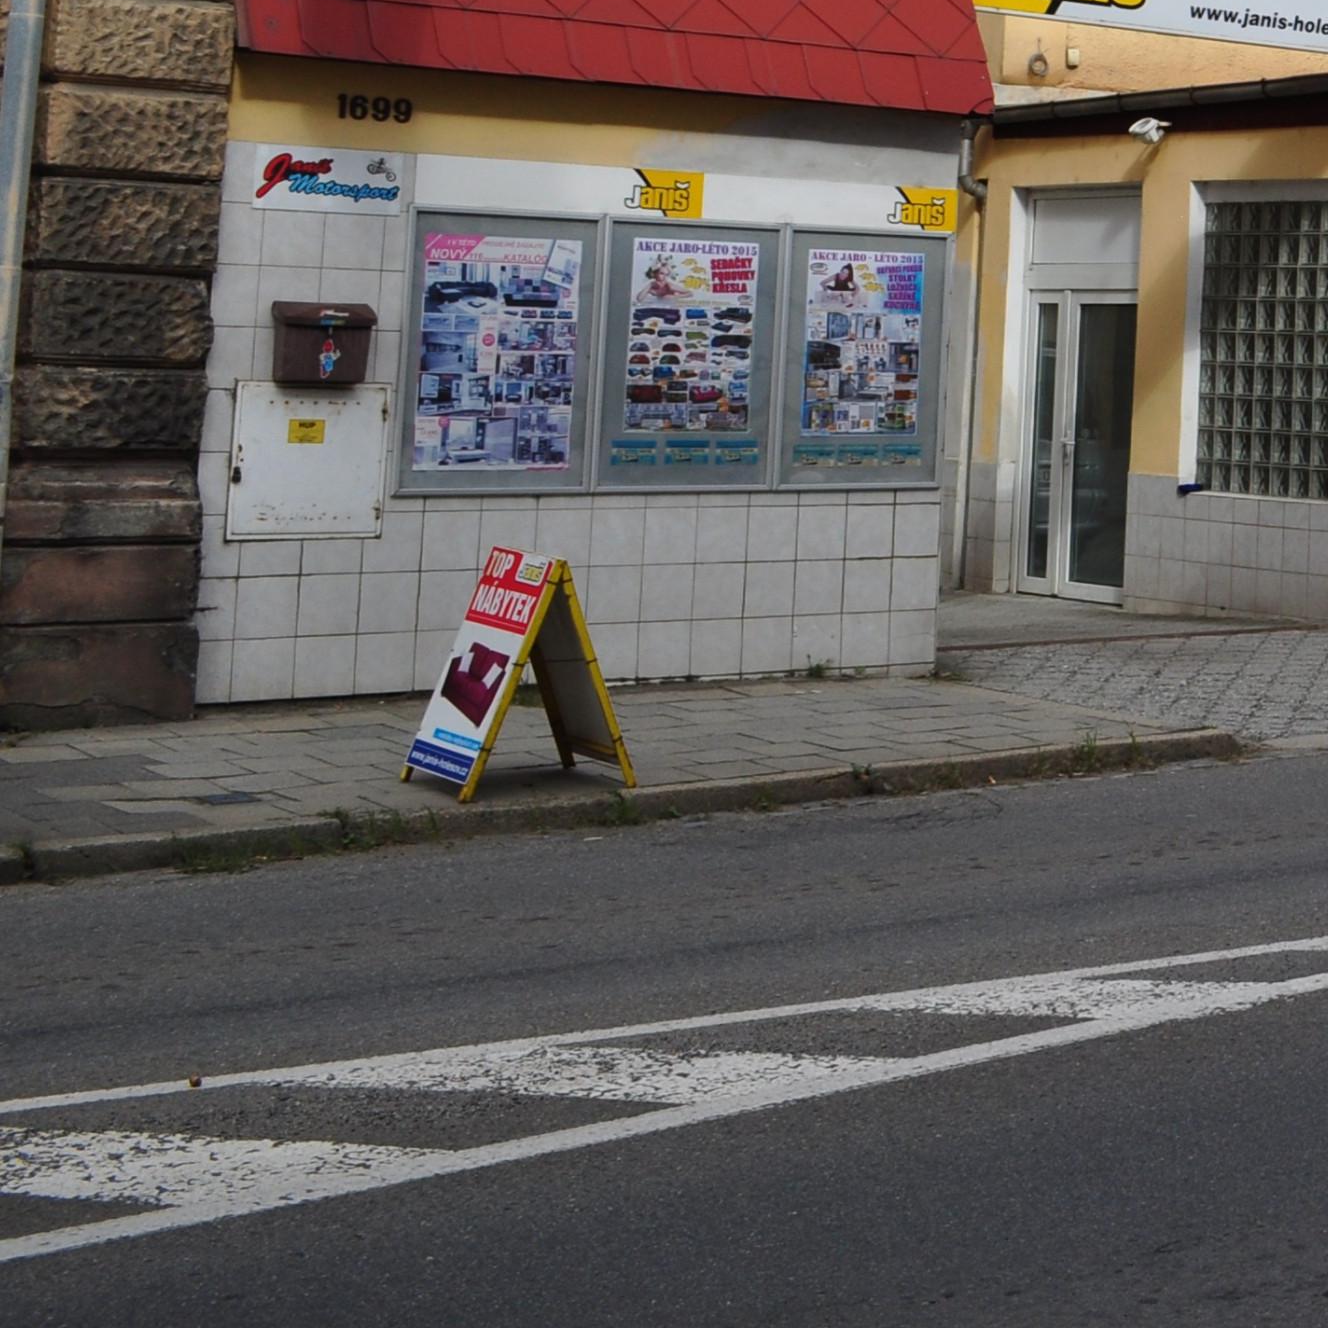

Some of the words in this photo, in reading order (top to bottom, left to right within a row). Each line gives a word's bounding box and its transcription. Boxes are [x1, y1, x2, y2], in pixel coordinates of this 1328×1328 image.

[337, 93, 413, 124] 1699
[288, 171, 400, 204] Motorsport
[624, 180, 691, 212] Janiš
[887, 196, 946, 226] Janiš
[430, 248, 467, 260] NOVÝ
[636, 241, 667, 253] AKCE
[731, 245, 758, 257] 2015
[811, 251, 838, 261] AKCE
[839, 252, 867, 262] JARO
[900, 254, 923, 264] 2015
[486, 550, 515, 579] TOP
[471, 580, 537, 624] NÁBYTEK
